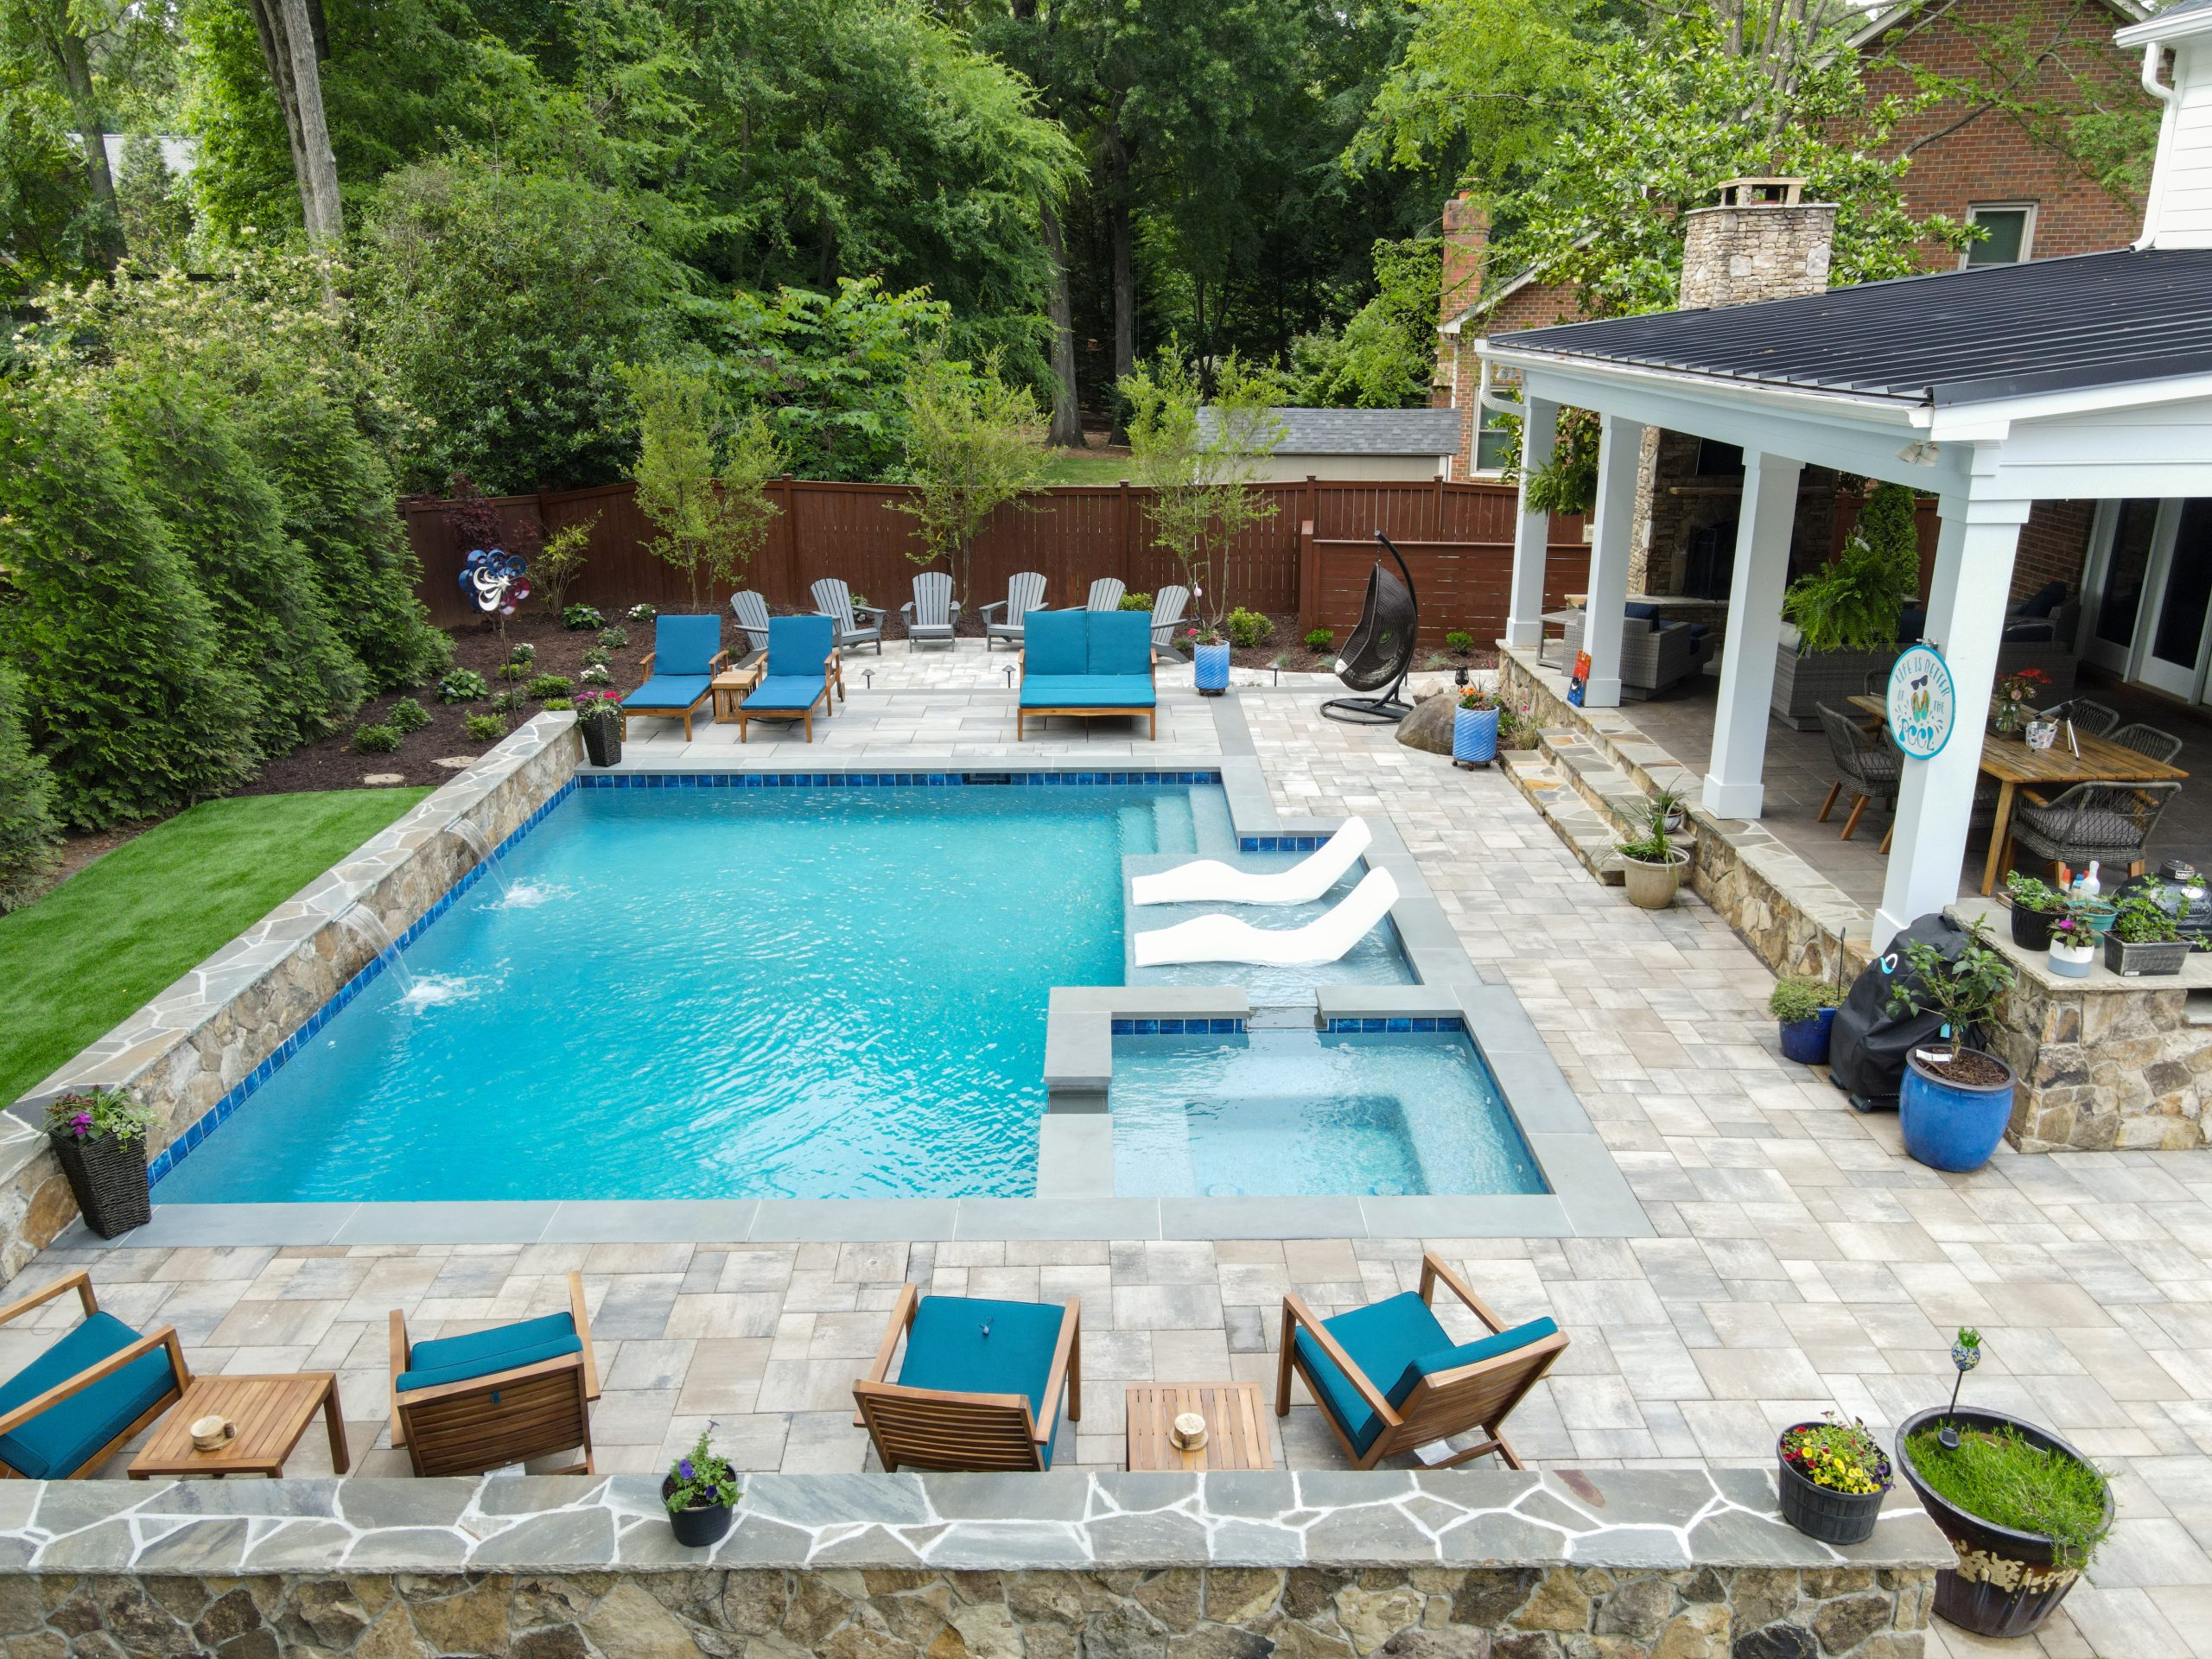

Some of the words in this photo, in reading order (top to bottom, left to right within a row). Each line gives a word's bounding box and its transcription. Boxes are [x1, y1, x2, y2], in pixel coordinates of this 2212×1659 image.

[1895, 659, 1912, 683] LIFE
[1915, 657, 1922, 671] IS
[1924, 658, 1950, 697] BETTER
[1897, 689, 1904, 701] AT
[1934, 700, 1945, 715] THE
[1899, 718, 1935, 752] POOL
